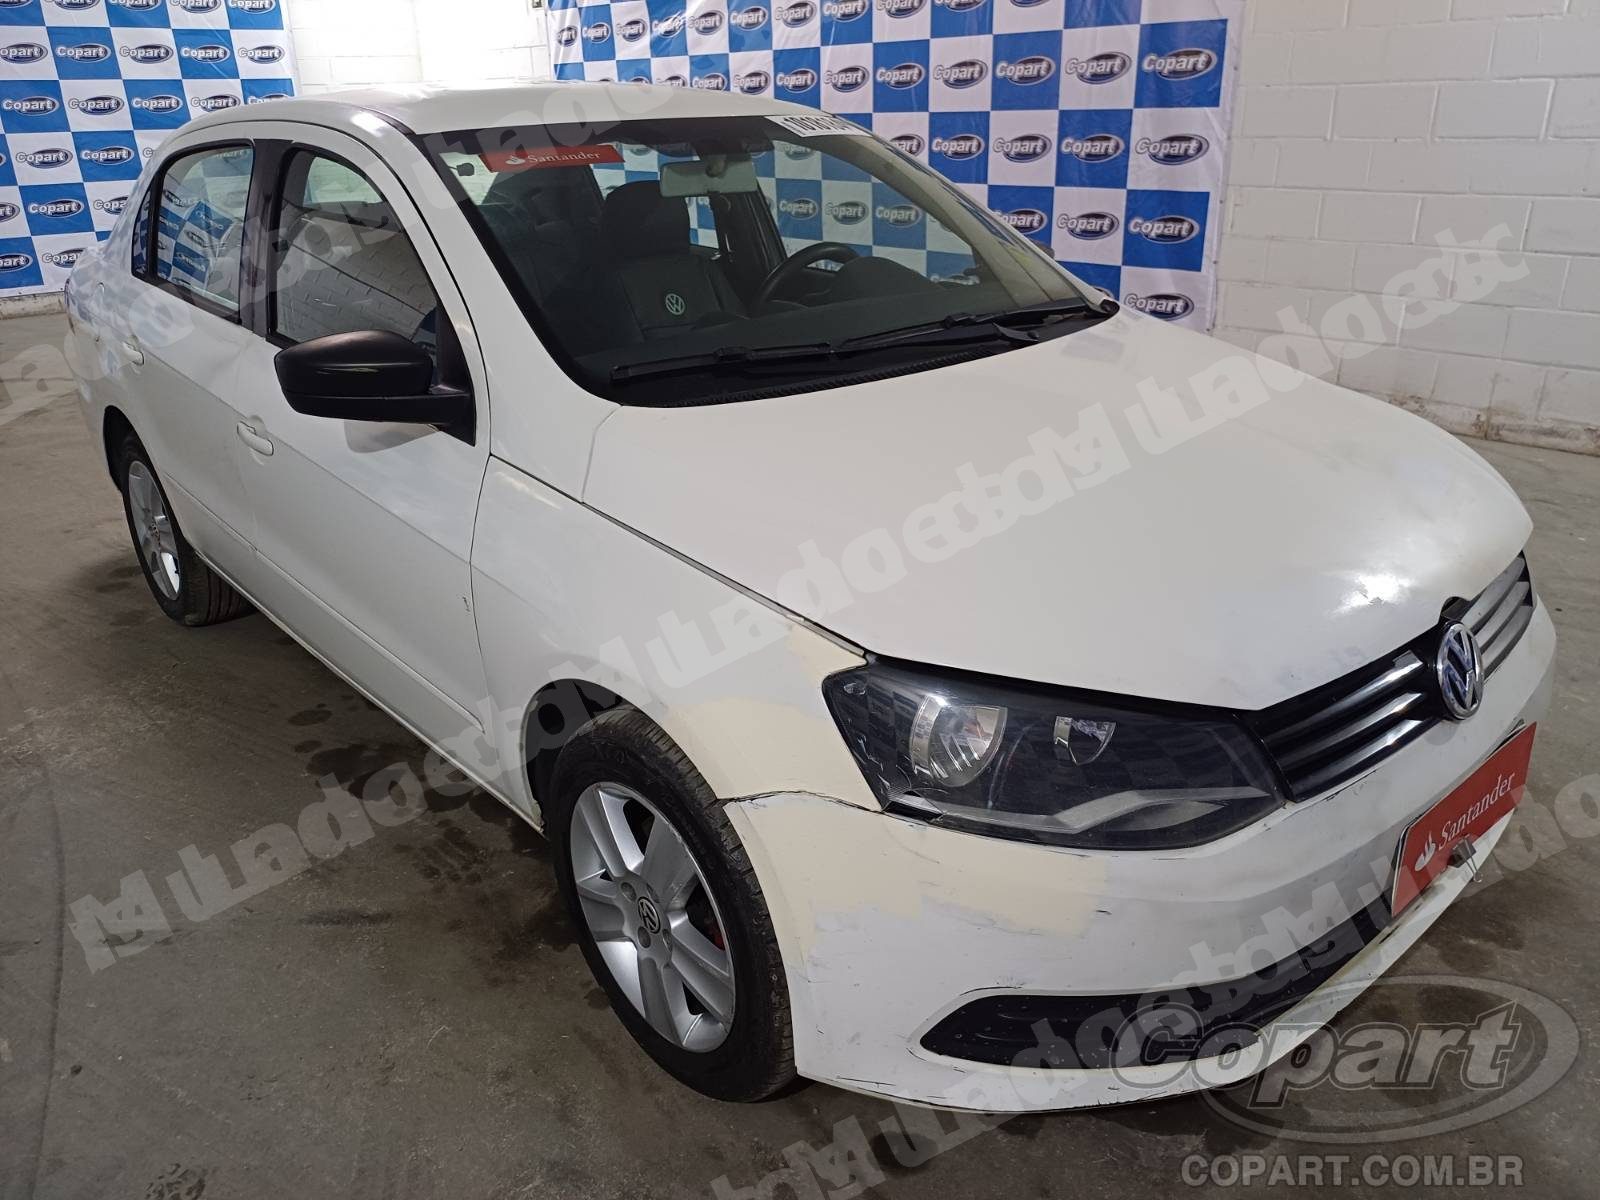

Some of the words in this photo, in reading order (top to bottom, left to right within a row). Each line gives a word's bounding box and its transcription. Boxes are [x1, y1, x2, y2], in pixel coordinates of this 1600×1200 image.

[228, 0, 271, 9] Copart
[823, 0, 863, 16] Copart
[730, 9, 763, 25] Copart
[775, 5, 810, 21] Copart
[688, 15, 720, 29] Copart
[0, 46, 41, 60] opart
[56, 45, 105, 60] Copart
[119, 45, 167, 60] Copart
[181, 46, 226, 60] Copart
[238, 47, 281, 61] Copart
[995, 60, 1047, 79] Copart
[1065, 56, 1121, 77] Copart
[1142, 52, 1207, 74] Copart
[776, 71, 814, 88] Copart
[824, 69, 863, 87] Copart
[876, 68, 919, 84] Copart
[933, 64, 979, 81] Copart
[692, 76, 723, 89] Copart
[734, 74, 769, 90] Copart
[2, 98, 54, 113] Copart
[68, 98, 118, 112] Copart
[132, 97, 178, 111] Copart
[190, 96, 234, 111] Copart
[932, 137, 978, 154] Copart
[993, 137, 1042, 155] Copart
[1061, 138, 1115, 158] Copart
[1135, 137, 1199, 158] Copart
[16, 150, 65, 165] Copart
[81, 149, 128, 163] Copart
[527, 151, 601, 163] Santander
[29, 201, 77, 218] Copart
[93, 199, 128, 214] Copa
[779, 200, 813, 216] Copart
[825, 202, 863, 219] Copart
[875, 206, 916, 223] Copart
[1057, 213, 1111, 232] Copart
[1129, 217, 1190, 238] Copart
[1124, 293, 1185, 313] Copart
[1438, 772, 1515, 851] Santander
